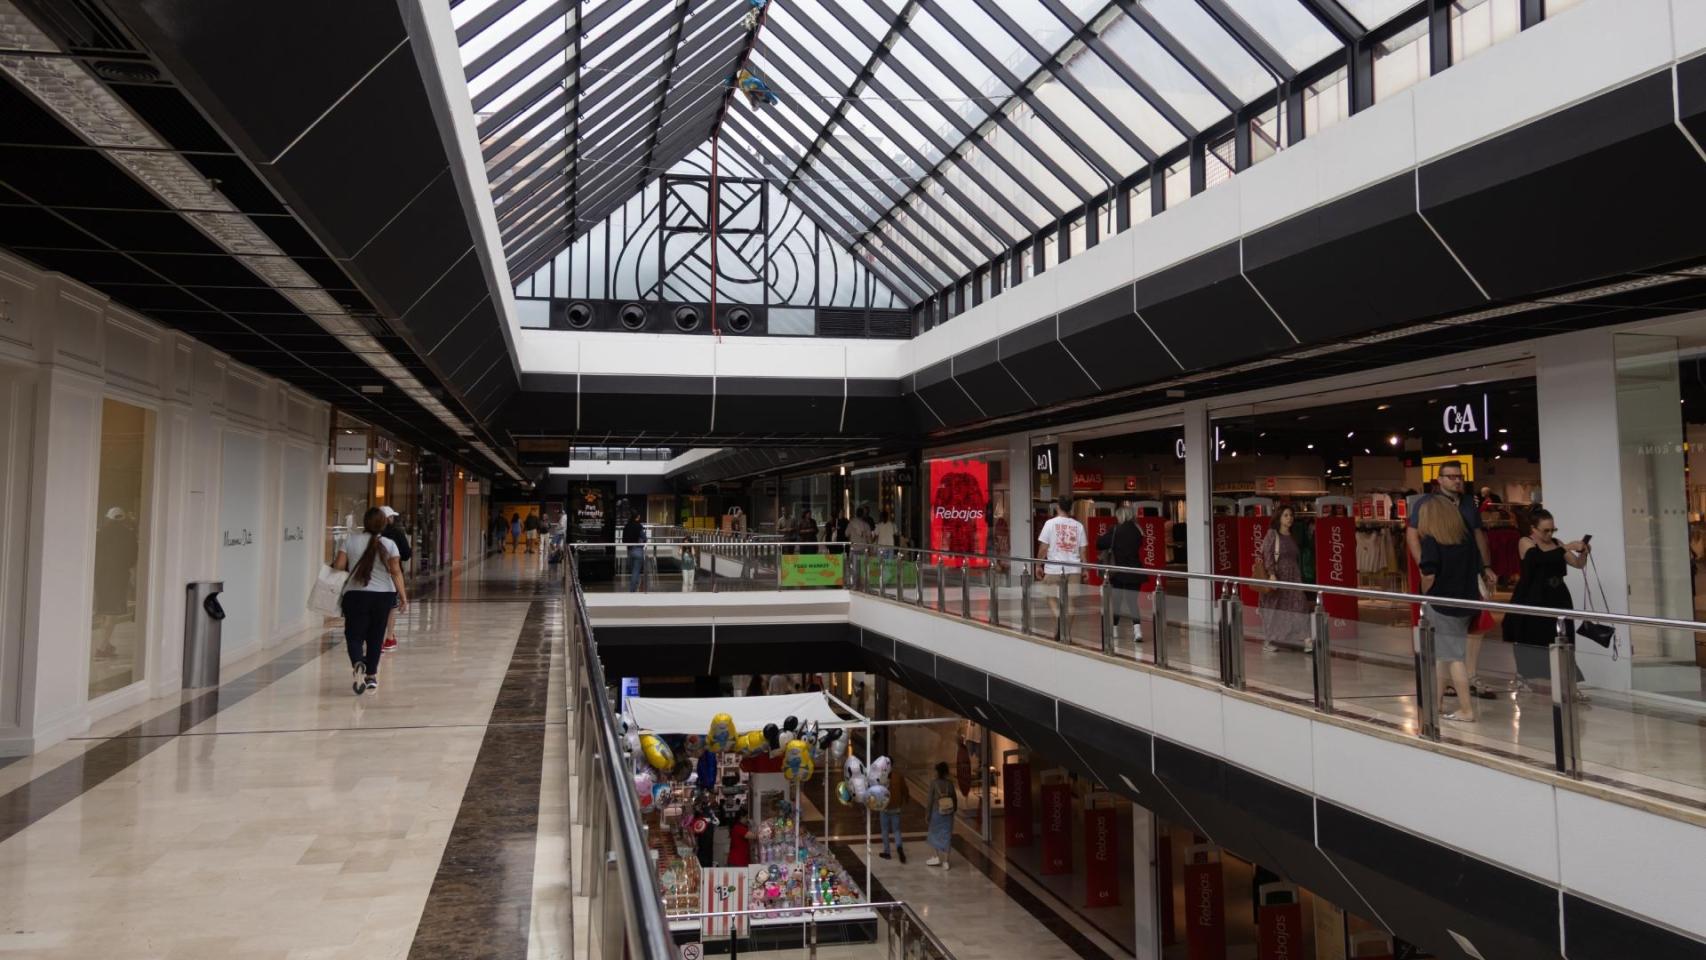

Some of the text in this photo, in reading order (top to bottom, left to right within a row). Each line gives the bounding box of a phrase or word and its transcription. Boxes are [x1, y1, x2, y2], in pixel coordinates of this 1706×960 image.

[1442, 403, 1478, 433] C&A
[935, 506, 983, 522] Rebajas
[1144, 523, 1155, 565] Rebajas
[1329, 526, 1344, 581] Rebajas
[1011, 770, 1024, 808] Rebajas
[1050, 791, 1063, 832] Rebajas
[1096, 816, 1107, 862] Rebajas
[1198, 873, 1213, 927] Rebajas
